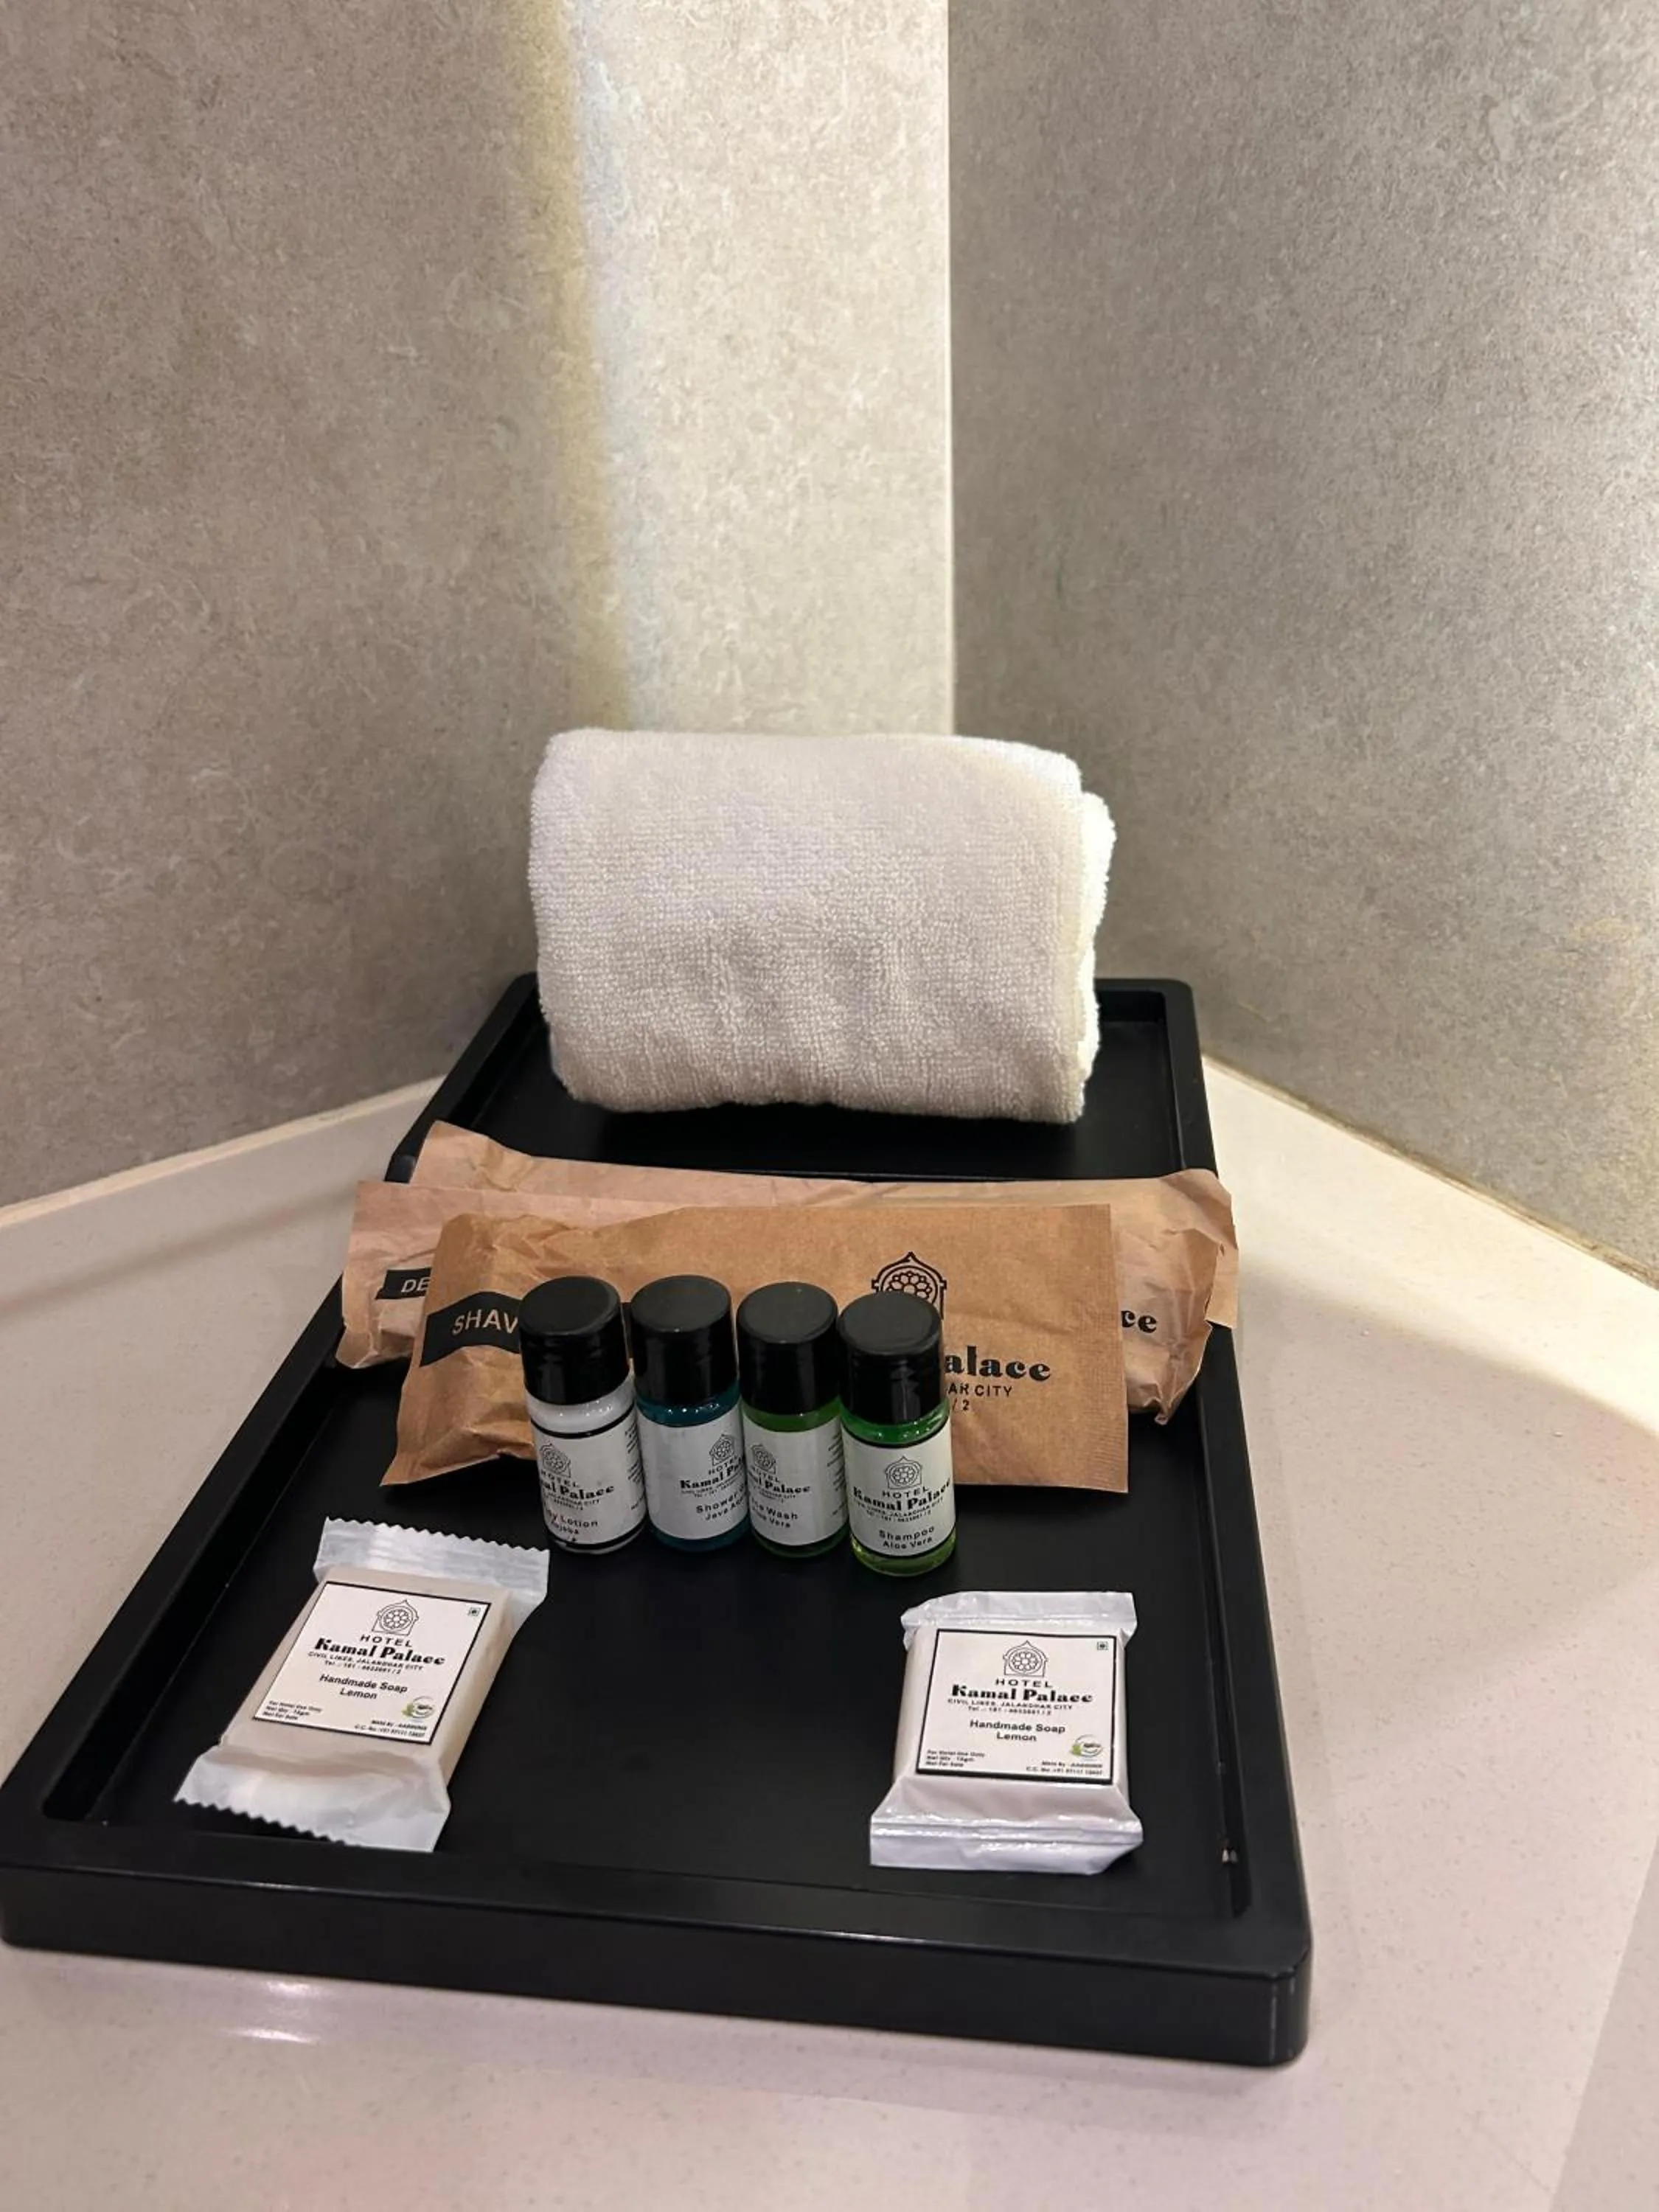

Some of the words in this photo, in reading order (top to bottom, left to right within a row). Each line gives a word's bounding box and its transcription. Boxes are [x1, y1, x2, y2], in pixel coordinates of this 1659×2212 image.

[400, 1276, 431, 1293] DE
[451, 1309, 518, 1335] SHAV
[1120, 1310, 1158, 1334] ce
[944, 1344, 1051, 1382] alace
[947, 1382, 970, 1395] AR
[974, 1384, 1013, 1397] CITY
[680, 1471, 724, 1489] Kamal
[765, 1479, 812, 1494] Palace
[560, 1485, 615, 1500] Palace
[853, 1486, 902, 1511] Kamal
[882, 1486, 929, 1499] HOTEL
[767, 1506, 799, 1520] Wash
[560, 1514, 599, 1528] Lotion
[879, 1525, 935, 1541] Shampoo
[883, 1540, 907, 1550] Aloe
[909, 1536, 933, 1548] Vera
[360, 1634, 413, 1648] HOTEL
[314, 1637, 378, 1658] Kamal
[380, 1646, 446, 1666] Palace
[319, 1674, 377, 1689] Handmade
[380, 1682, 408, 1694] Soap
[995, 1678, 1054, 1688] HOTEL
[340, 1687, 378, 1700] Lemon
[951, 1684, 1017, 1700] Kamal
[1022, 1688, 1093, 1703] Palace
[970, 1719, 1032, 1731] Handmade
[1035, 1724, 1065, 1734] Soap
[996, 1731, 1037, 1742] Lemon
